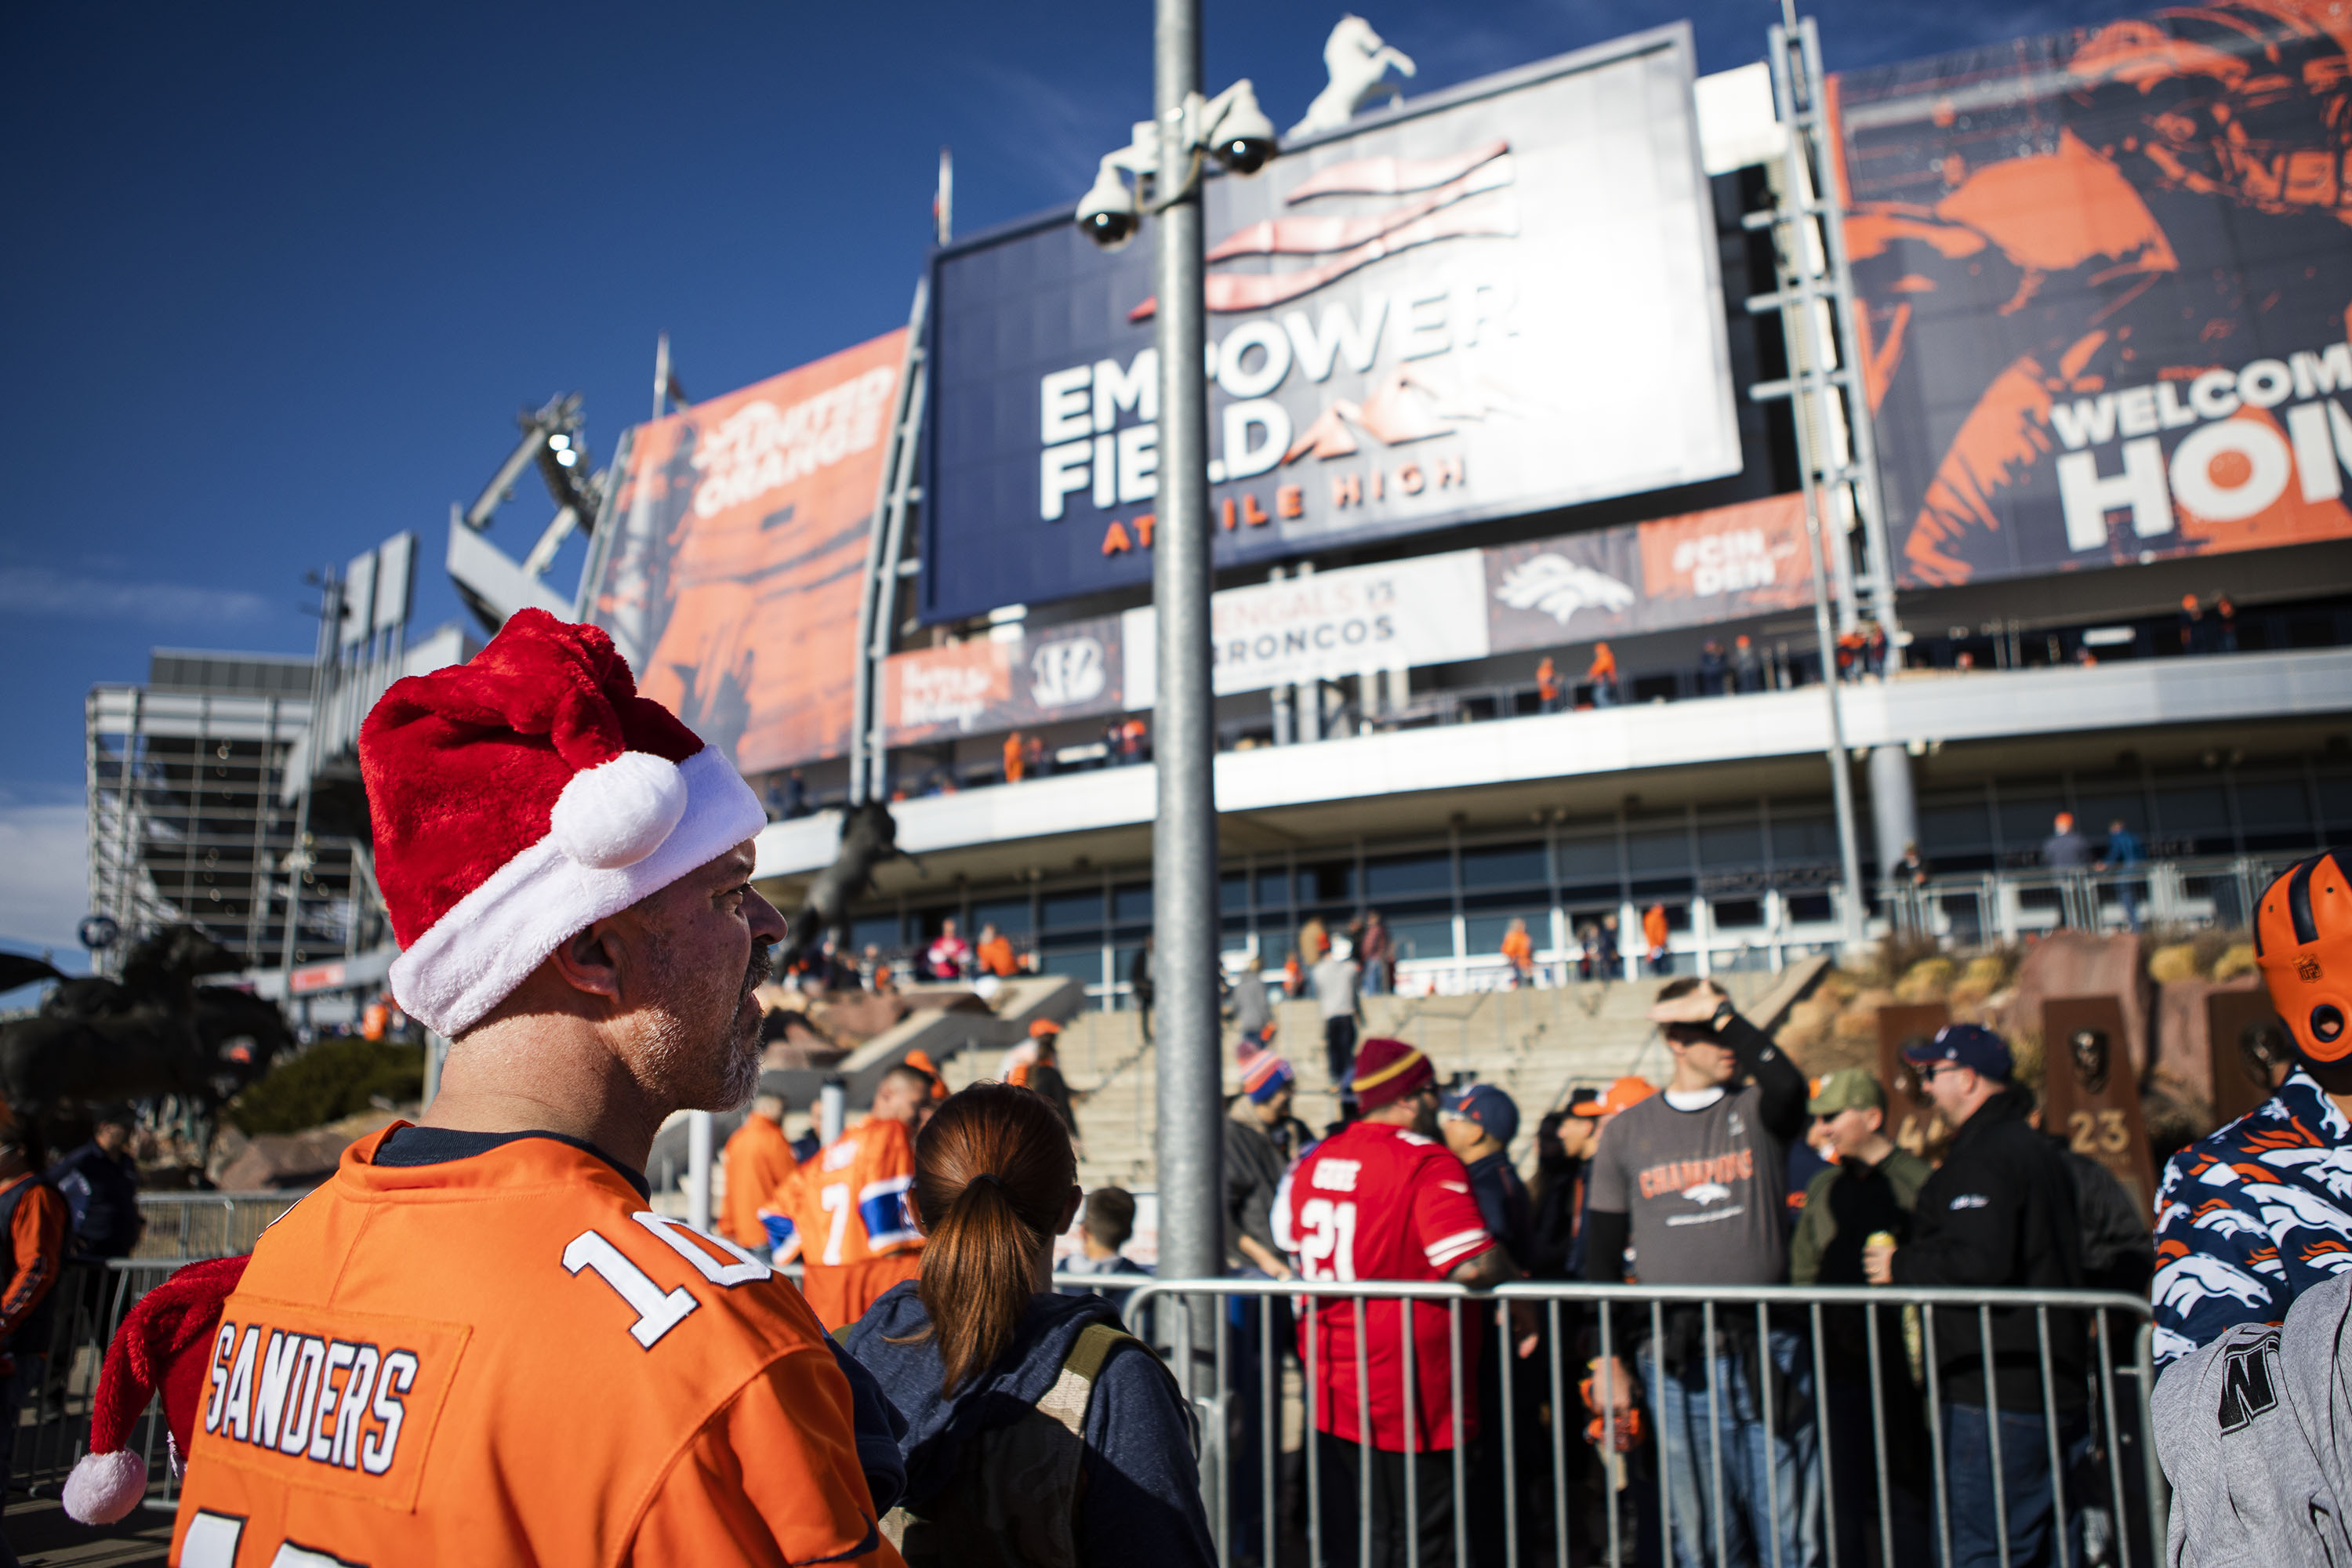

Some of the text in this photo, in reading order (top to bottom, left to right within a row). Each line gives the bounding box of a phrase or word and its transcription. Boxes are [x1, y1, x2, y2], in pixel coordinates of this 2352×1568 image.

[1041, 274, 1521, 445] EMOWER
[1041, 398, 1293, 521] FIED
[1221, 485, 1304, 531] ILE
[1333, 454, 1466, 510] HIGH
[1214, 615, 1396, 666] RONCOS
[2067, 1109, 2131, 1154] 23
[821, 1181, 850, 1267] 7
[1300, 1198, 1358, 1283] 21
[561, 1210, 774, 1351] 10
[205, 1320, 420, 1475] SANDERS
